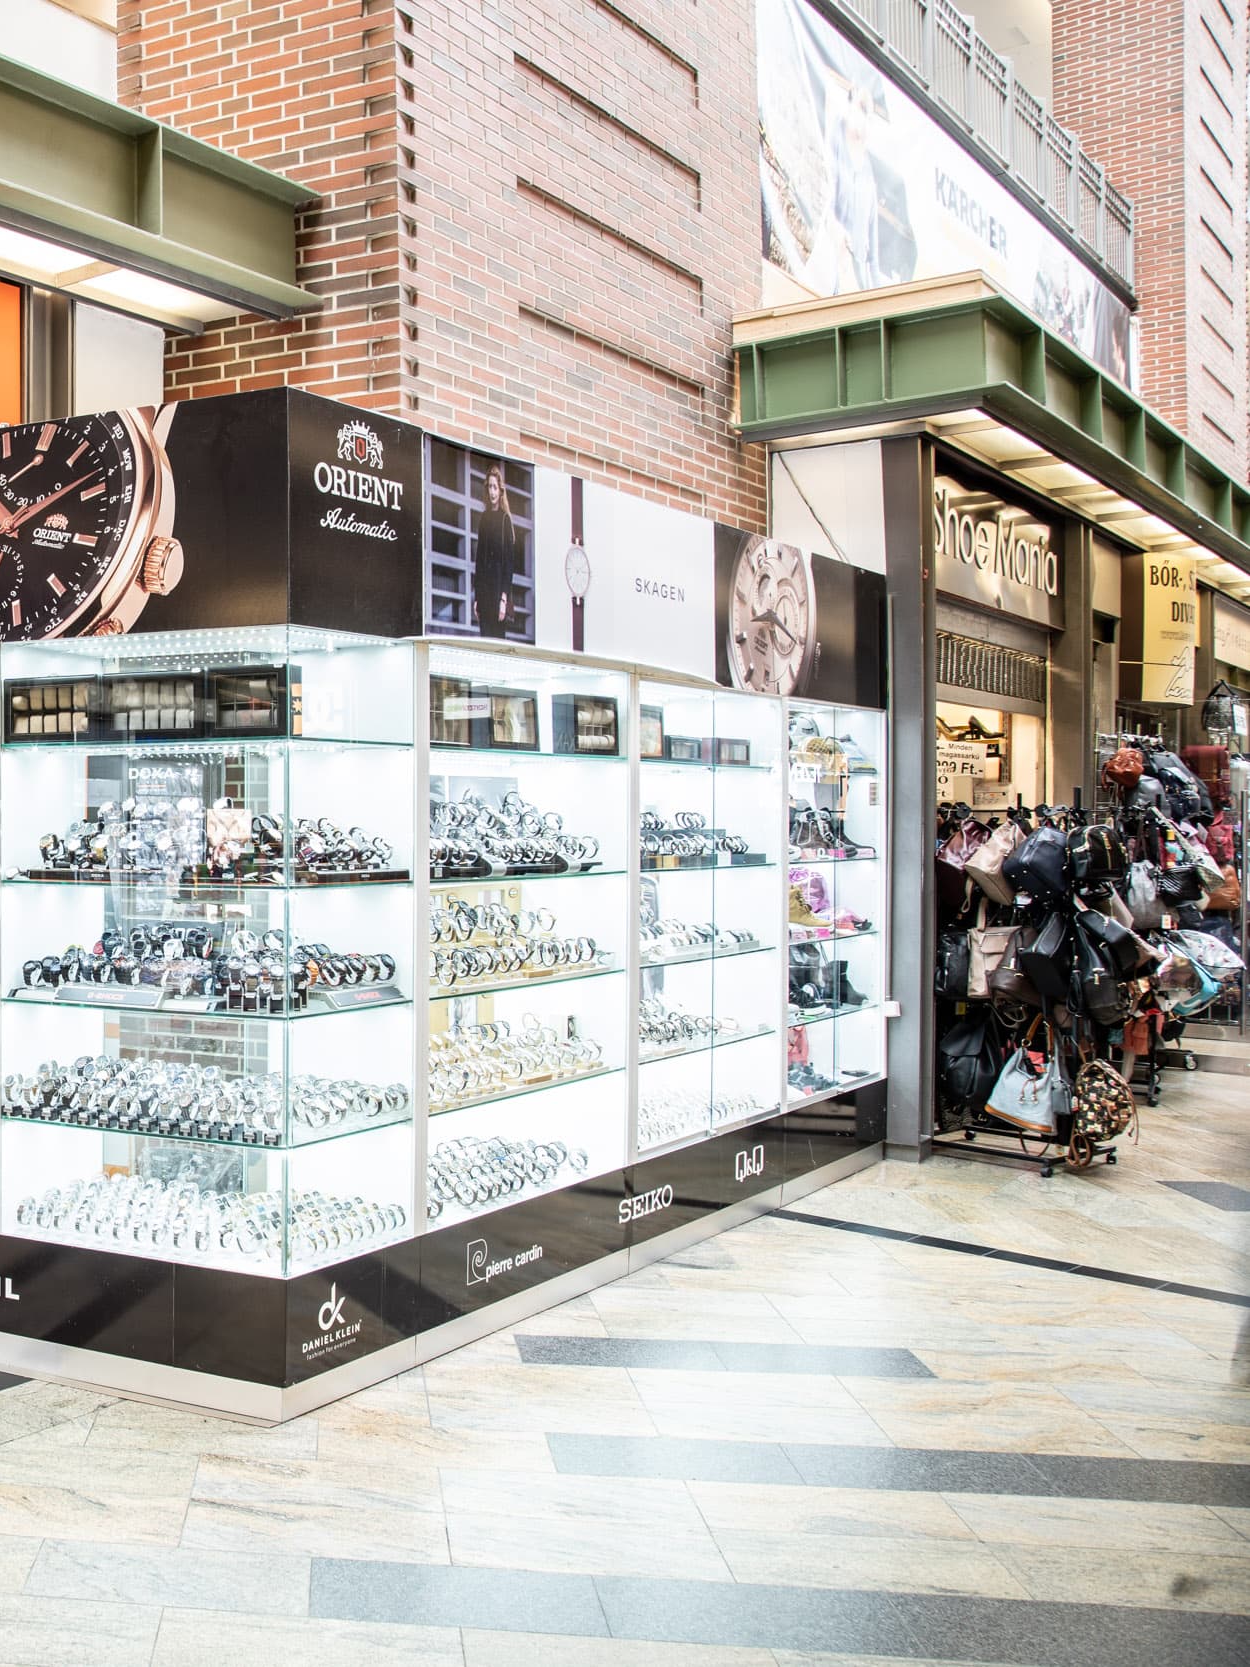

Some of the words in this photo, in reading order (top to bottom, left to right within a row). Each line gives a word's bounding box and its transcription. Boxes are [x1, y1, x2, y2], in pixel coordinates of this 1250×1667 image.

[313, 461, 404, 511] ORIENT
[32, 527, 72, 543] ORIENT
[319, 507, 399, 542] Automatic
[994, 512, 1058, 597] Mania
[634, 576, 686, 603] SKAGEN
[735, 1144, 765, 1183] Q&Q
[618, 1184, 674, 1225] SEIKO
[485, 1257, 513, 1284] pierre
[514, 1243, 544, 1267] cardin
[302, 1333, 335, 1354] DANIEL
[335, 1322, 361, 1341] KLEIN
